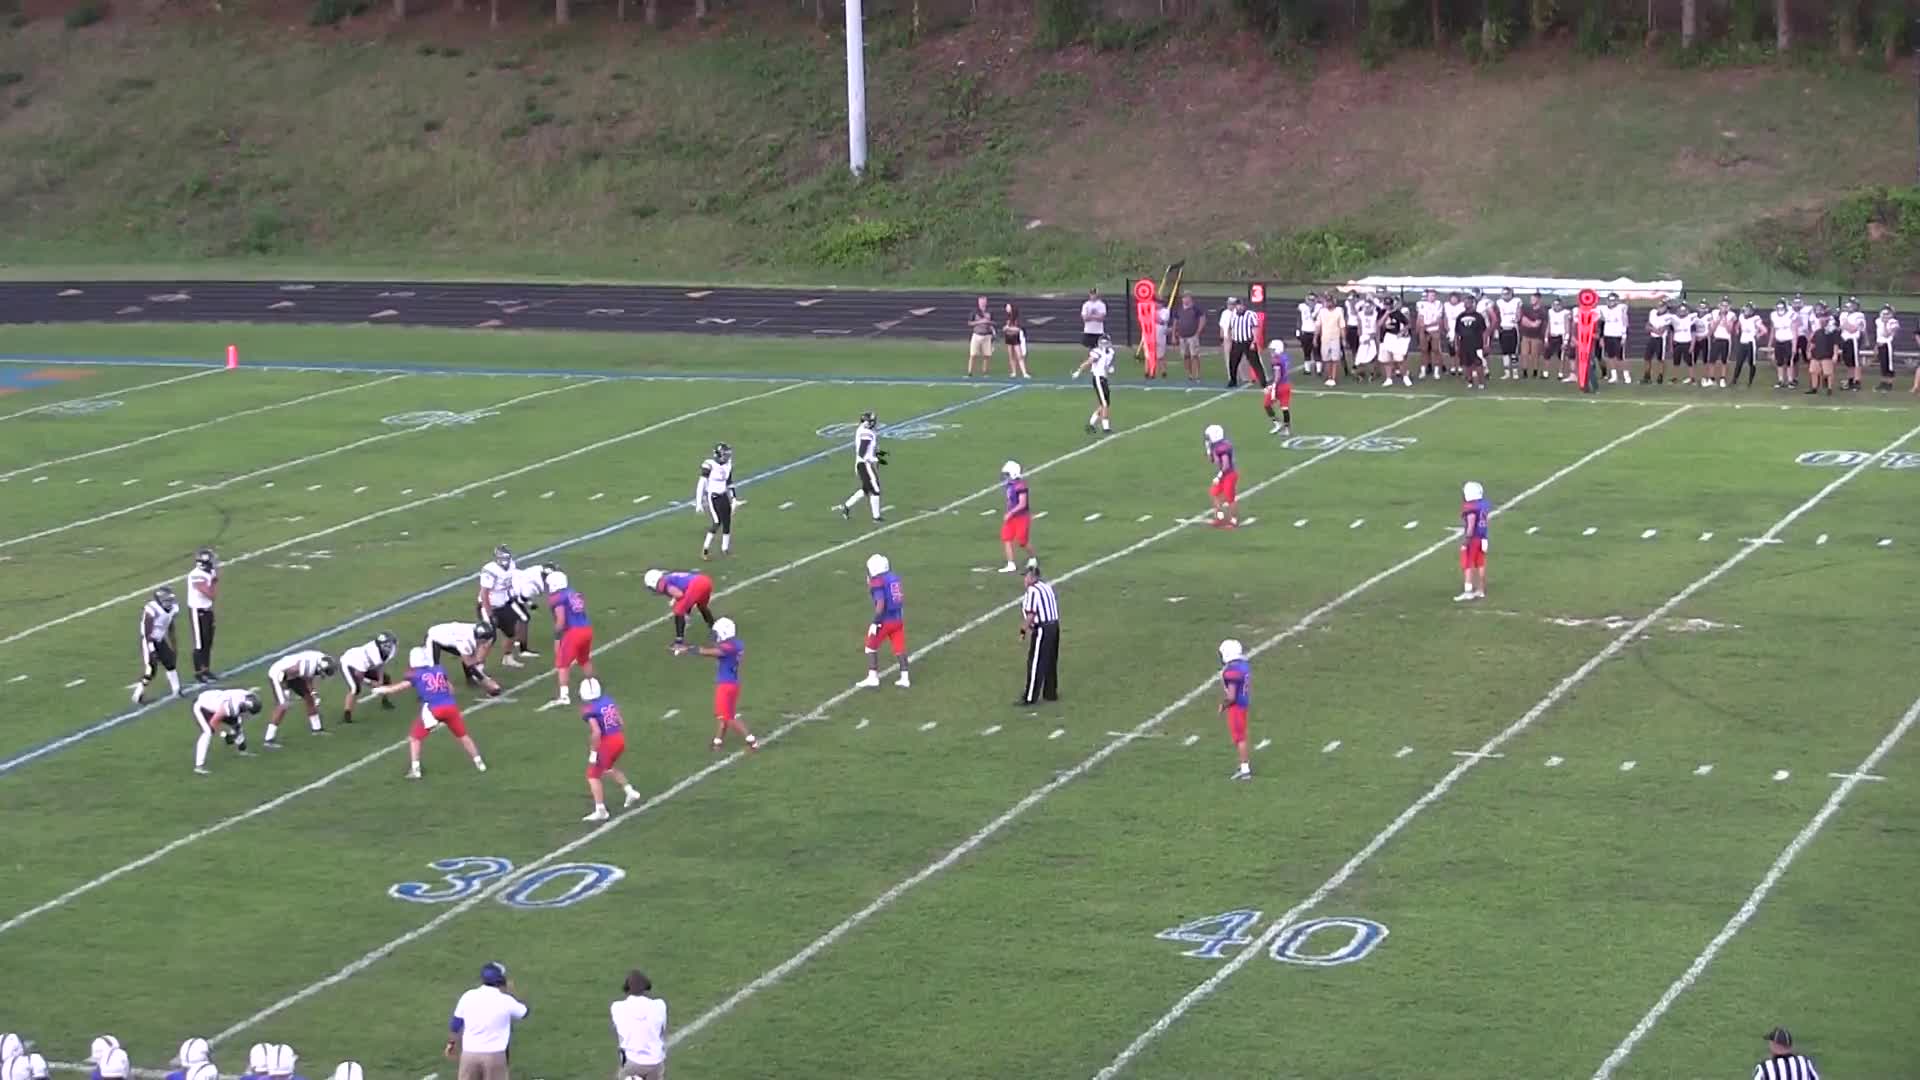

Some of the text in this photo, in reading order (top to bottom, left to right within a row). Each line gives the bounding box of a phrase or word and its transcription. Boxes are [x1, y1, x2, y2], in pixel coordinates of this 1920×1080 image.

[1251, 285, 1264, 302] 3
[421, 672, 450, 693] 34
[388, 856, 626, 909] 30
[1154, 909, 1390, 966] 40
